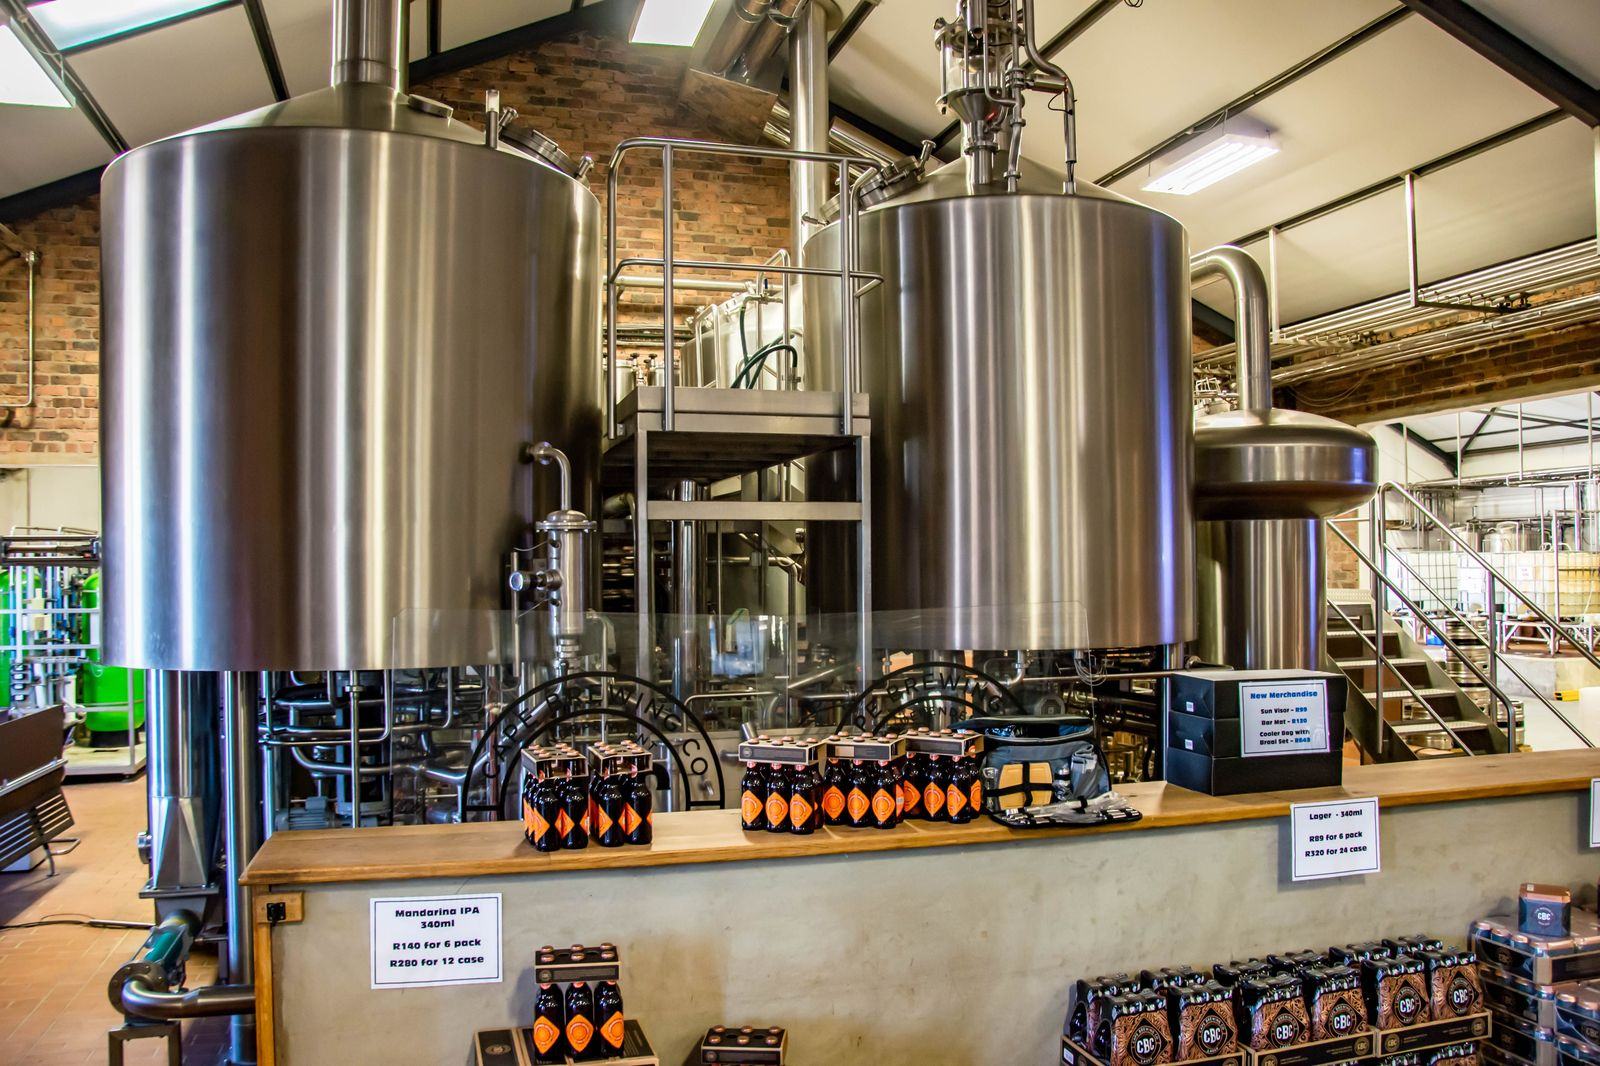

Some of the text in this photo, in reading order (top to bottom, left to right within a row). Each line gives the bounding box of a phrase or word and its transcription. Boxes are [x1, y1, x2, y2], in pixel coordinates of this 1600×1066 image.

[1269, 690, 1318, 699] Merchandise
[1309, 812, 1332, 820] Lager
[1340, 809, 1363, 817] 340ml
[1345, 831, 1363, 839] pack
[1305, 849, 1324, 857] R320
[1349, 845, 1367, 853] case
[395, 906, 480, 918] Mandarina IPA
[1537, 912, 1551, 921] CBC
[420, 919, 455, 929] 340ml
[392, 938, 481, 951] R140 for 6 pack
[389, 956, 484, 967] R280 for 12 case
[1452, 988, 1469, 1004] CBC
[1399, 998, 1416, 1013] CBC
[1334, 1014, 1351, 1029] CBC
[1203, 1027, 1221, 1044] CBC
[1276, 1024, 1293, 1040] CBC
[1136, 1037, 1155, 1054] CBC
